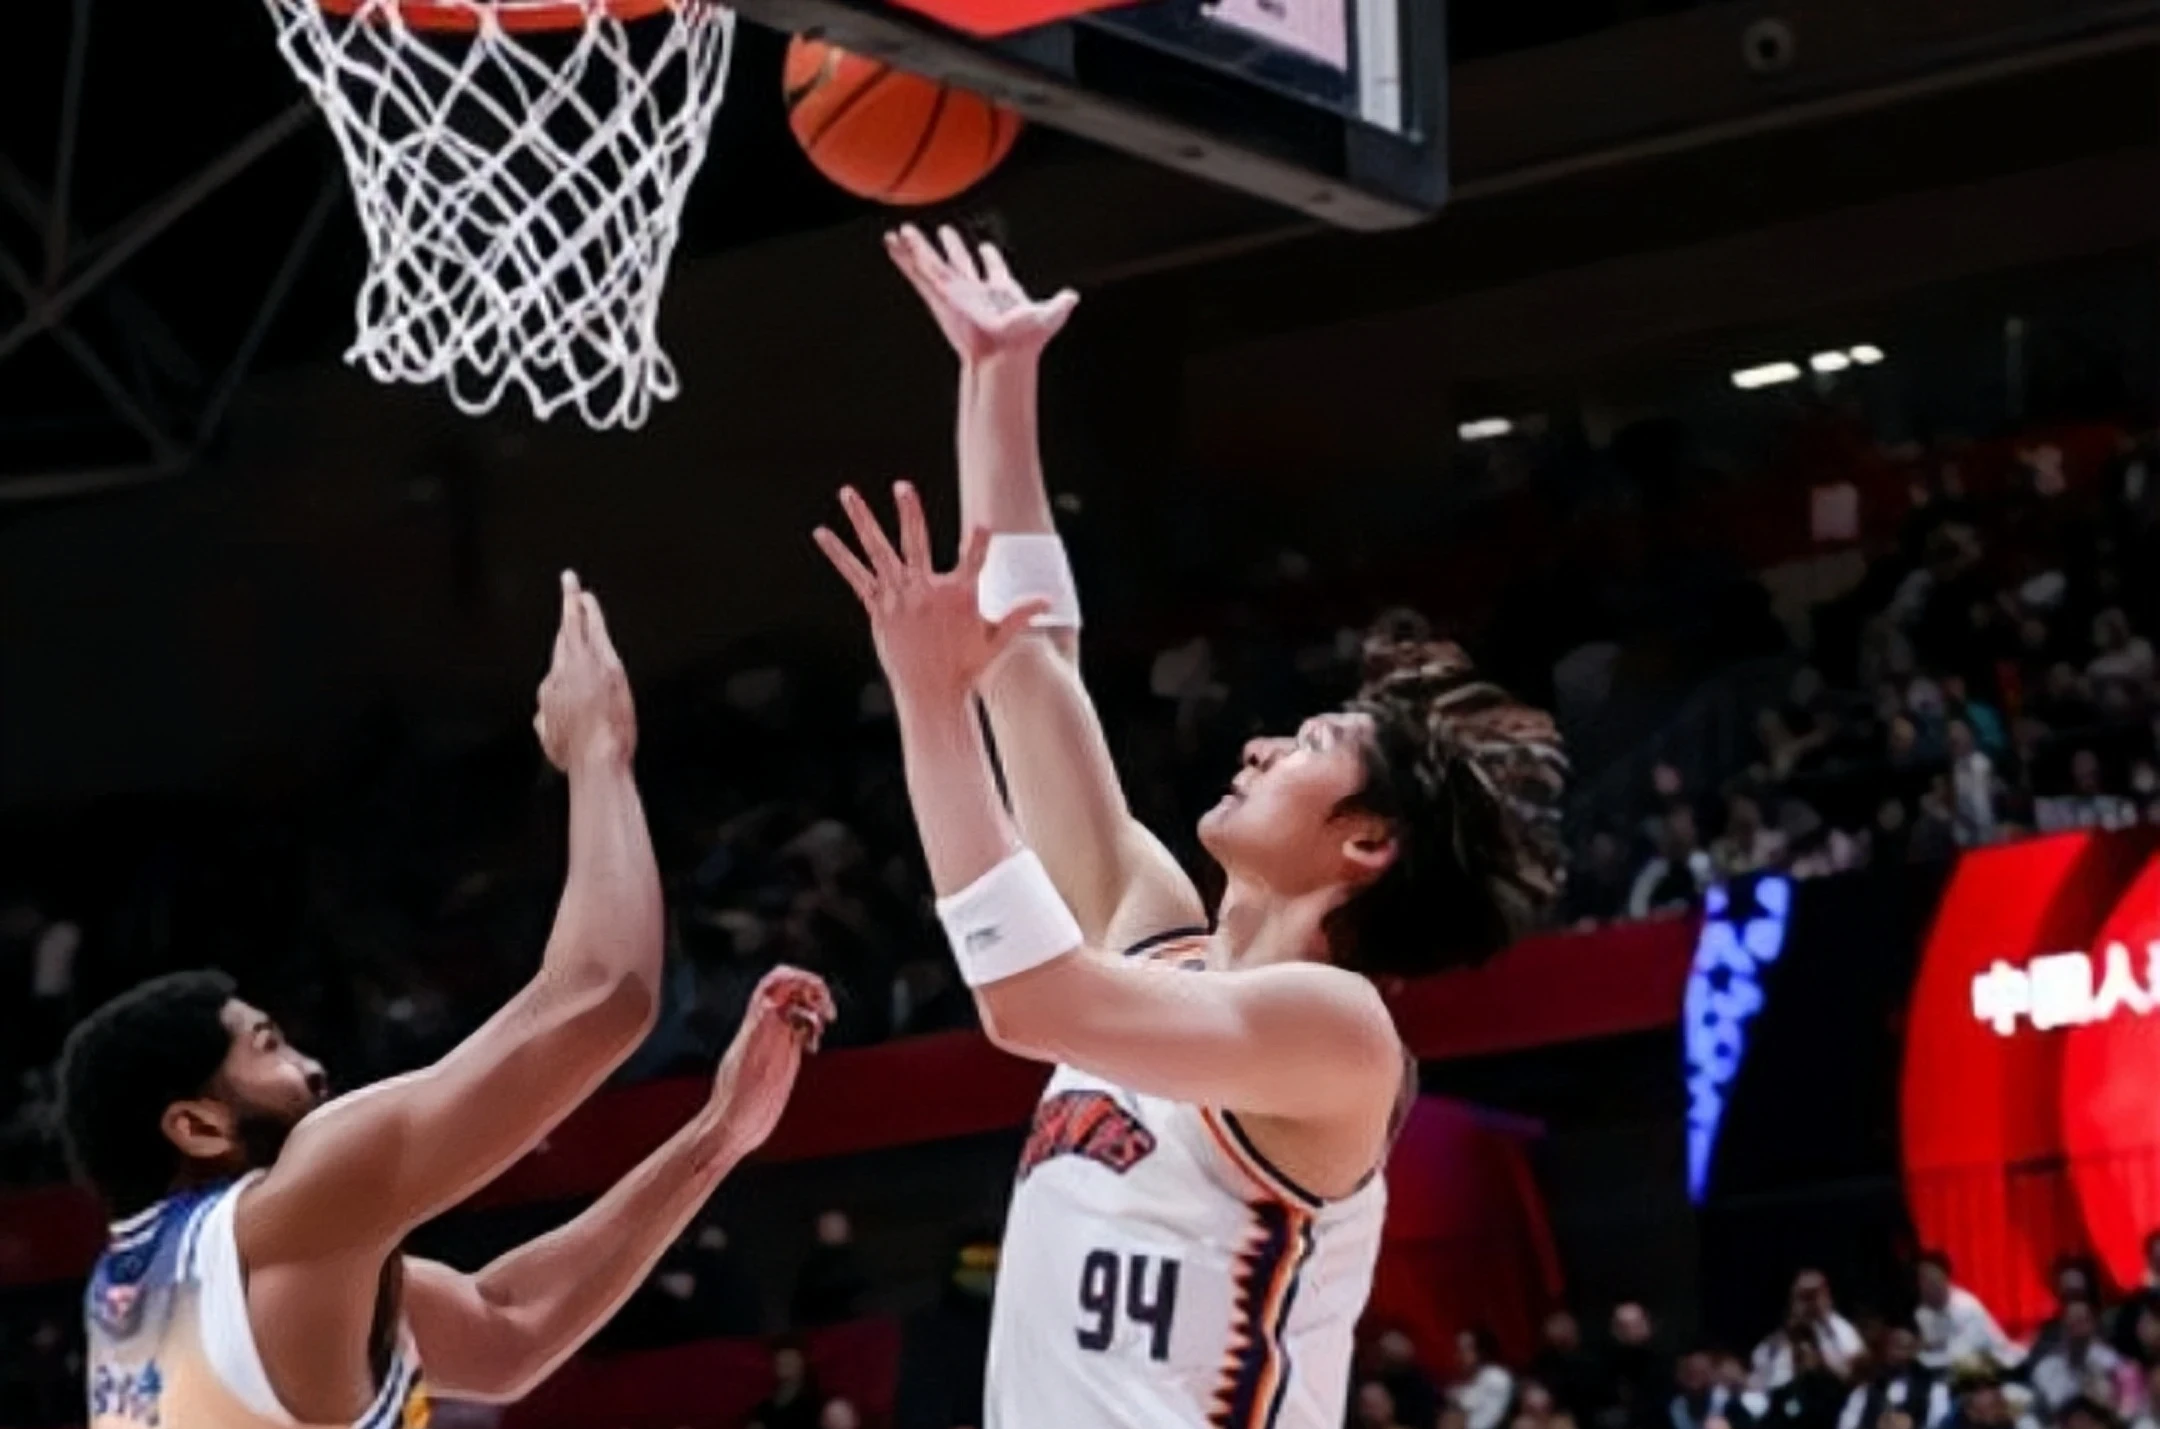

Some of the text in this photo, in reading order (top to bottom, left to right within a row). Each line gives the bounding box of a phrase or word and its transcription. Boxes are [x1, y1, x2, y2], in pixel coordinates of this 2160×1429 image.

[1971, 940, 2160, 1036] 中国人
[1076, 1249, 1181, 1362] 94
